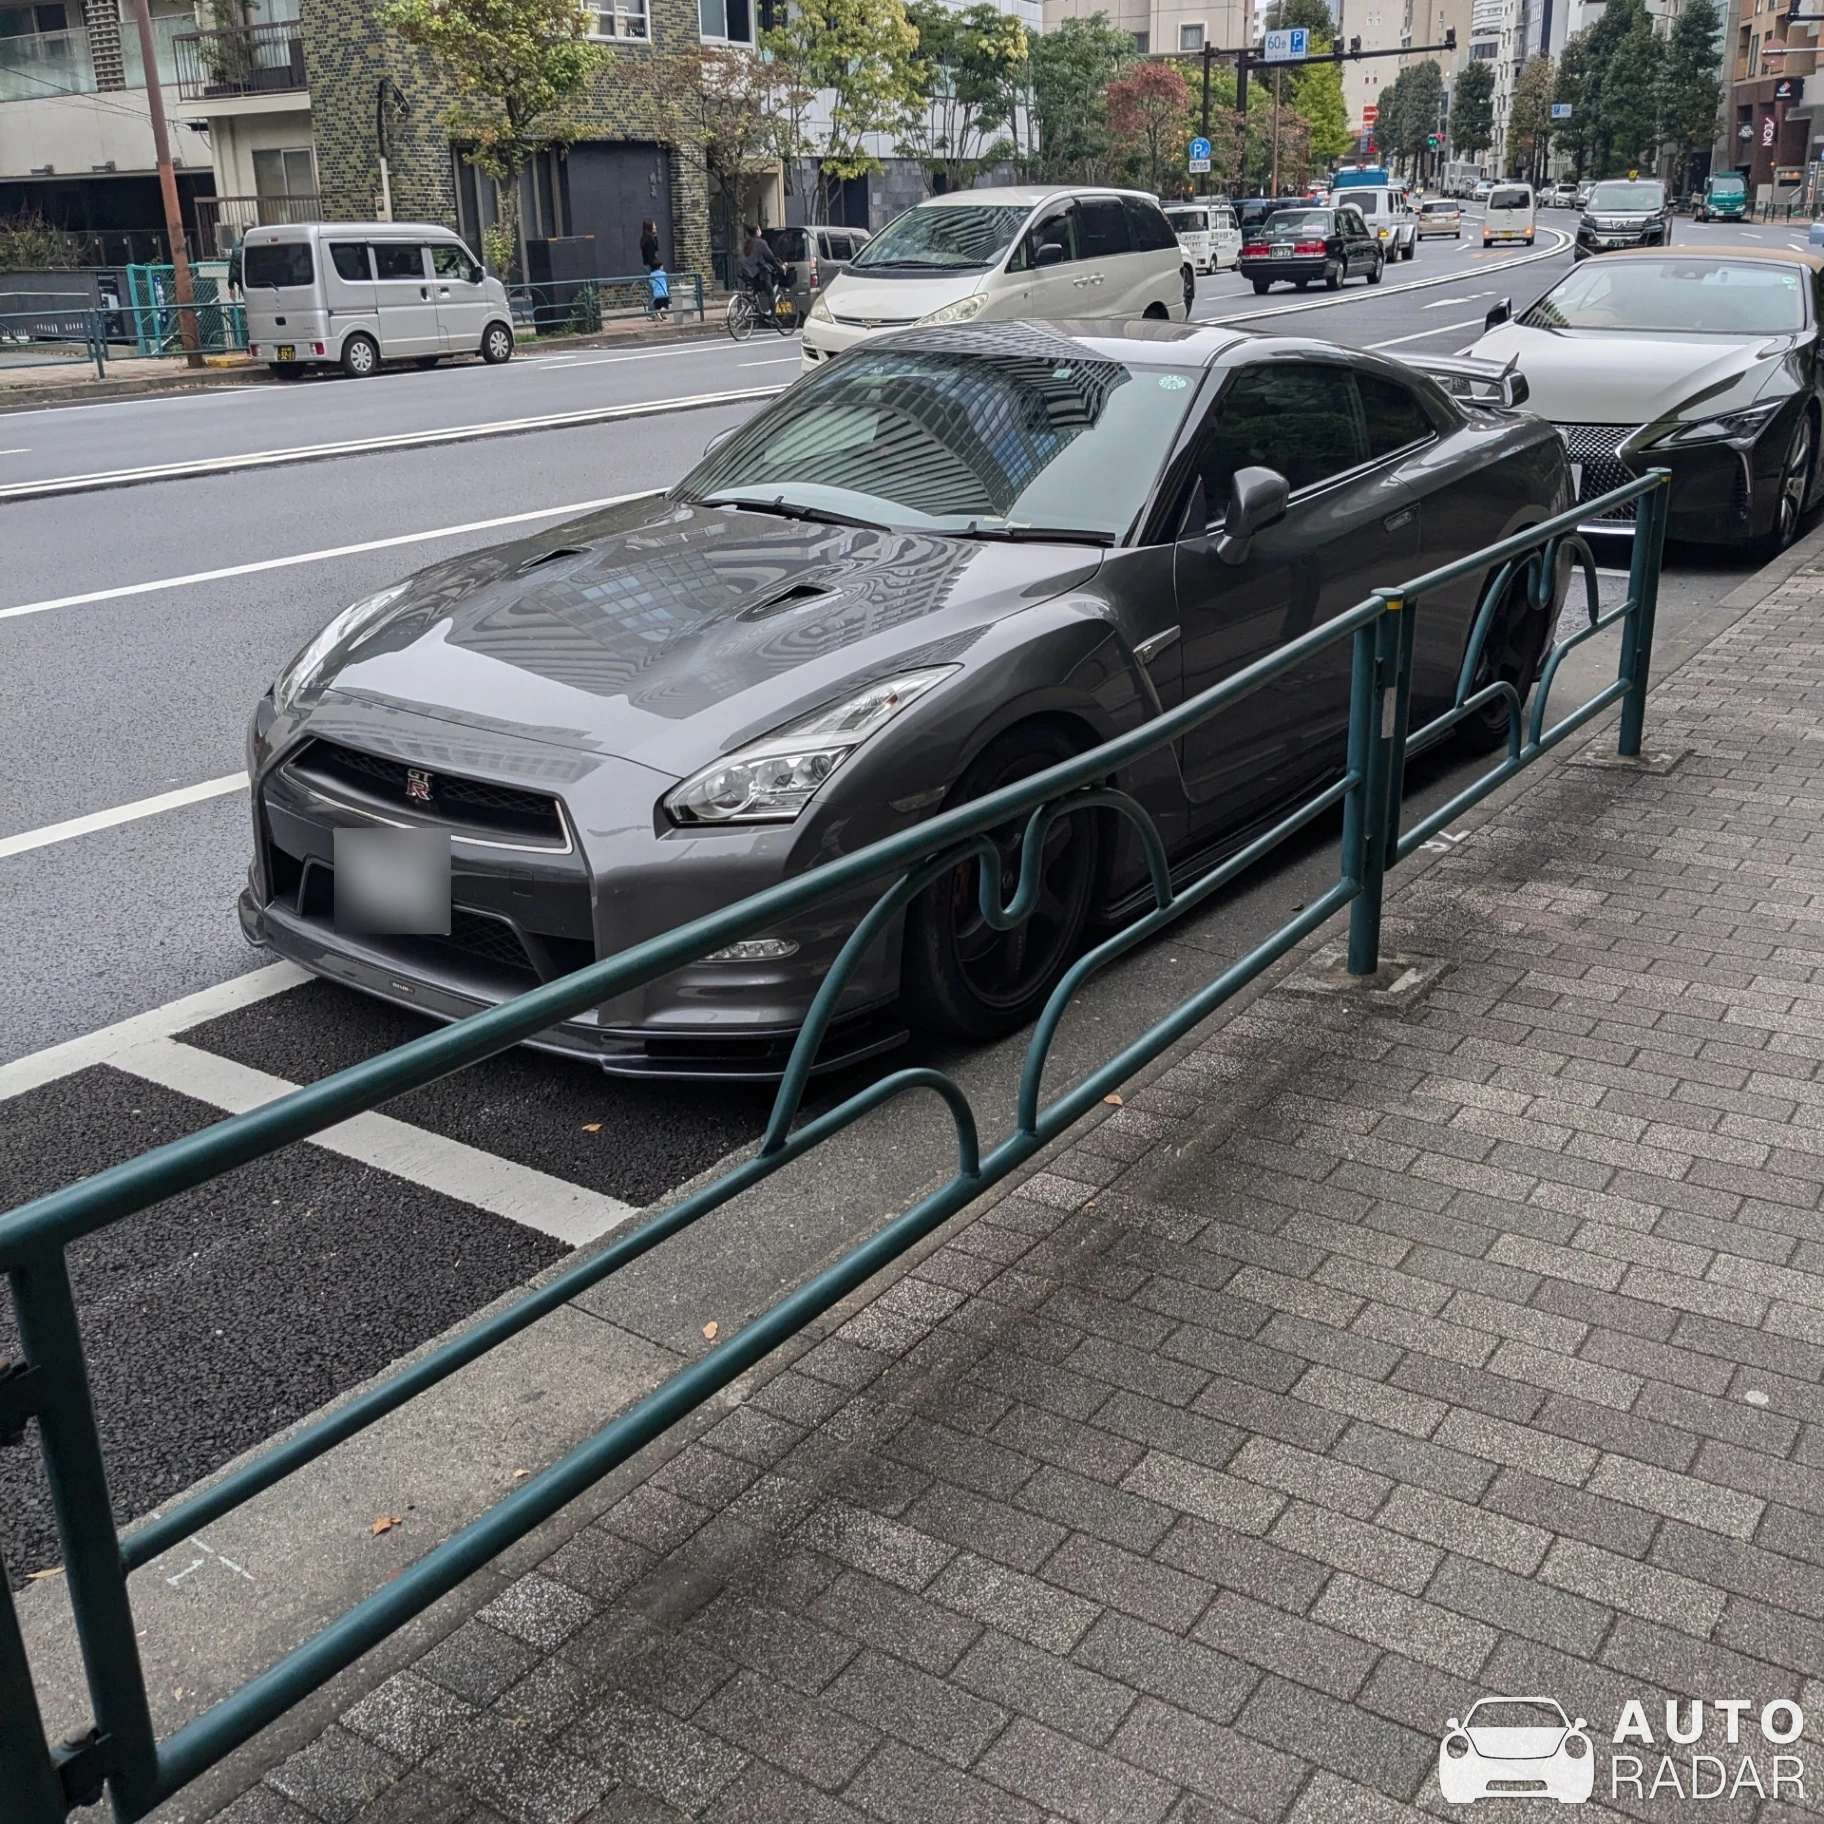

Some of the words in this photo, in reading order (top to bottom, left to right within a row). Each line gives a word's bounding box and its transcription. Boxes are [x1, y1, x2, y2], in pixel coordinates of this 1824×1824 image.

[1294, 32, 1302, 45] P
[407, 768, 434, 781] GT
[406, 778, 430, 800] R
